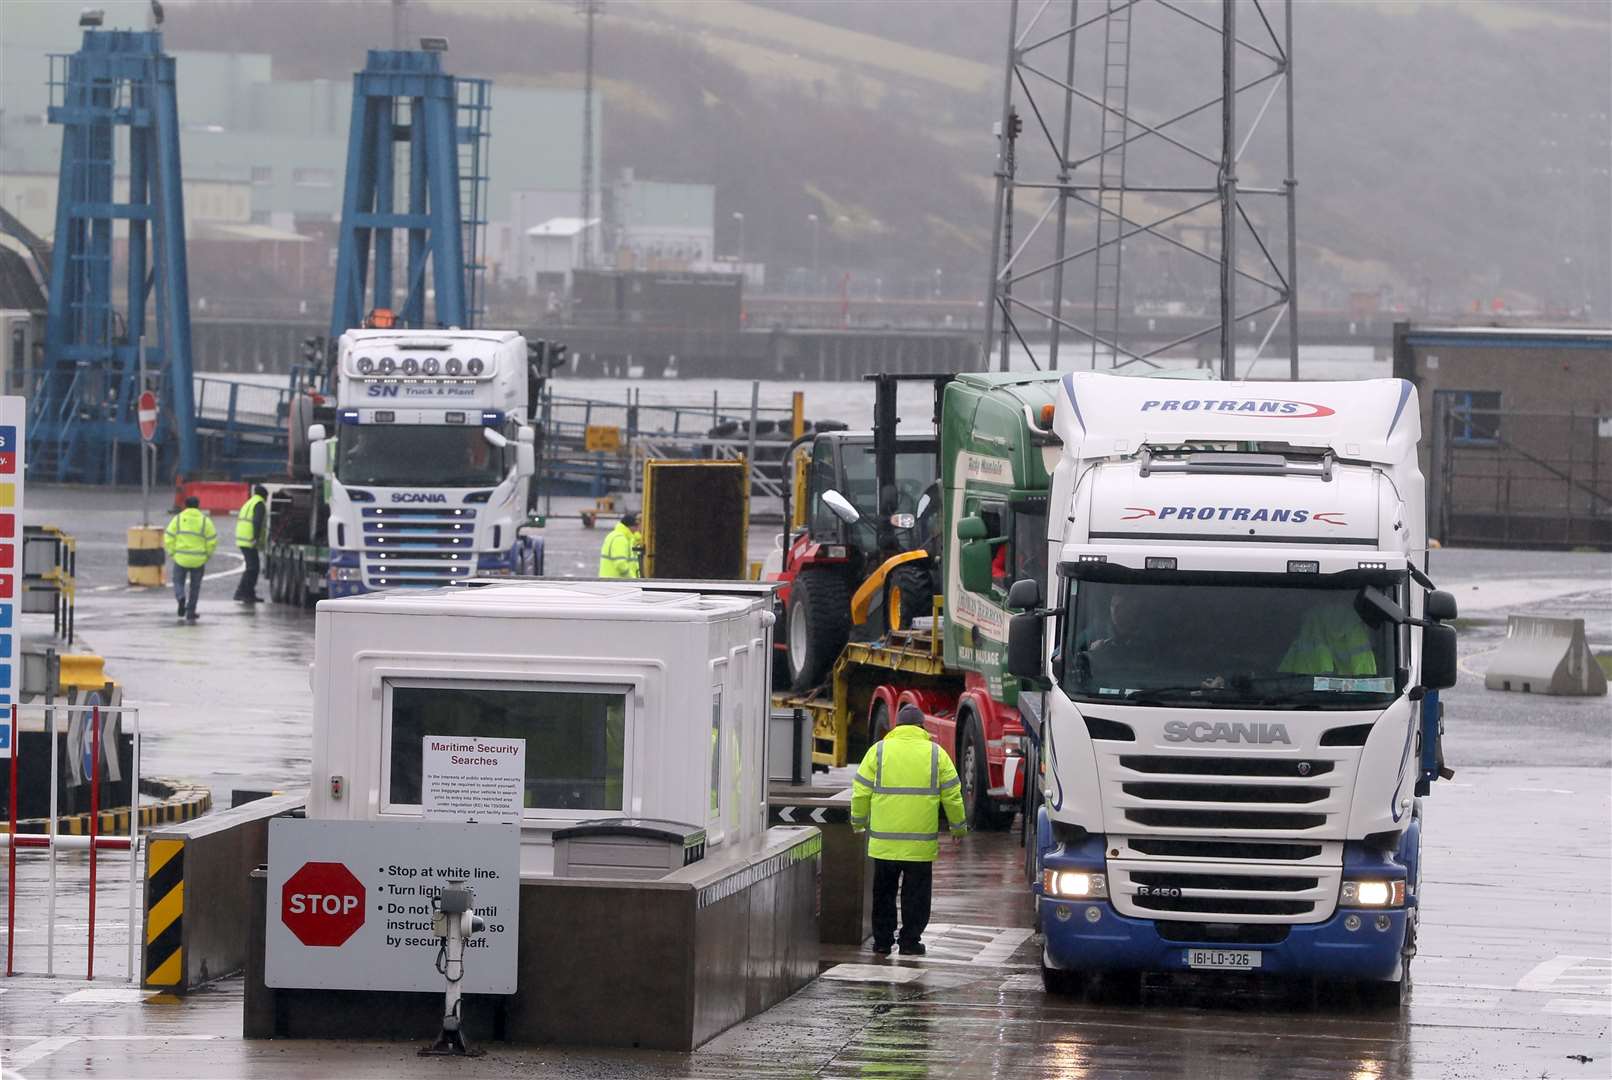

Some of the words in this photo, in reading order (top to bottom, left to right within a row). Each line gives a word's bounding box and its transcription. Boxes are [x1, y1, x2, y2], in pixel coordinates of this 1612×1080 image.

[367, 385, 399, 398] SN
[406, 387, 433, 396] Truck
[437, 388, 444, 396] &
[447, 388, 475, 397] Plant
[1140, 399, 1299, 413] PROTRANS
[391, 492, 447, 503] SCANIA
[1158, 507, 1309, 523] PROTRANS
[1163, 720, 1292, 744] SCANIA
[431, 742, 475, 752] Maritime
[477, 744, 519, 756] Security
[451, 755, 498, 766] Searches
[388, 865, 417, 878] Stop
[421, 867, 433, 877] at
[437, 867, 471, 878] white
[474, 868, 500, 879] line.
[387, 884, 415, 895] Turn
[419, 885, 442, 898] ligh
[1140, 887, 1150, 896] R
[1152, 888, 1180, 897] 450
[289, 894, 358, 915] STOP
[388, 903, 405, 914] Do
[408, 905, 429, 915] not
[489, 924, 505, 933] so
[386, 935, 401, 948] by
[462, 937, 489, 948] taff.
[1193, 951, 1249, 966] 161-LD-326
